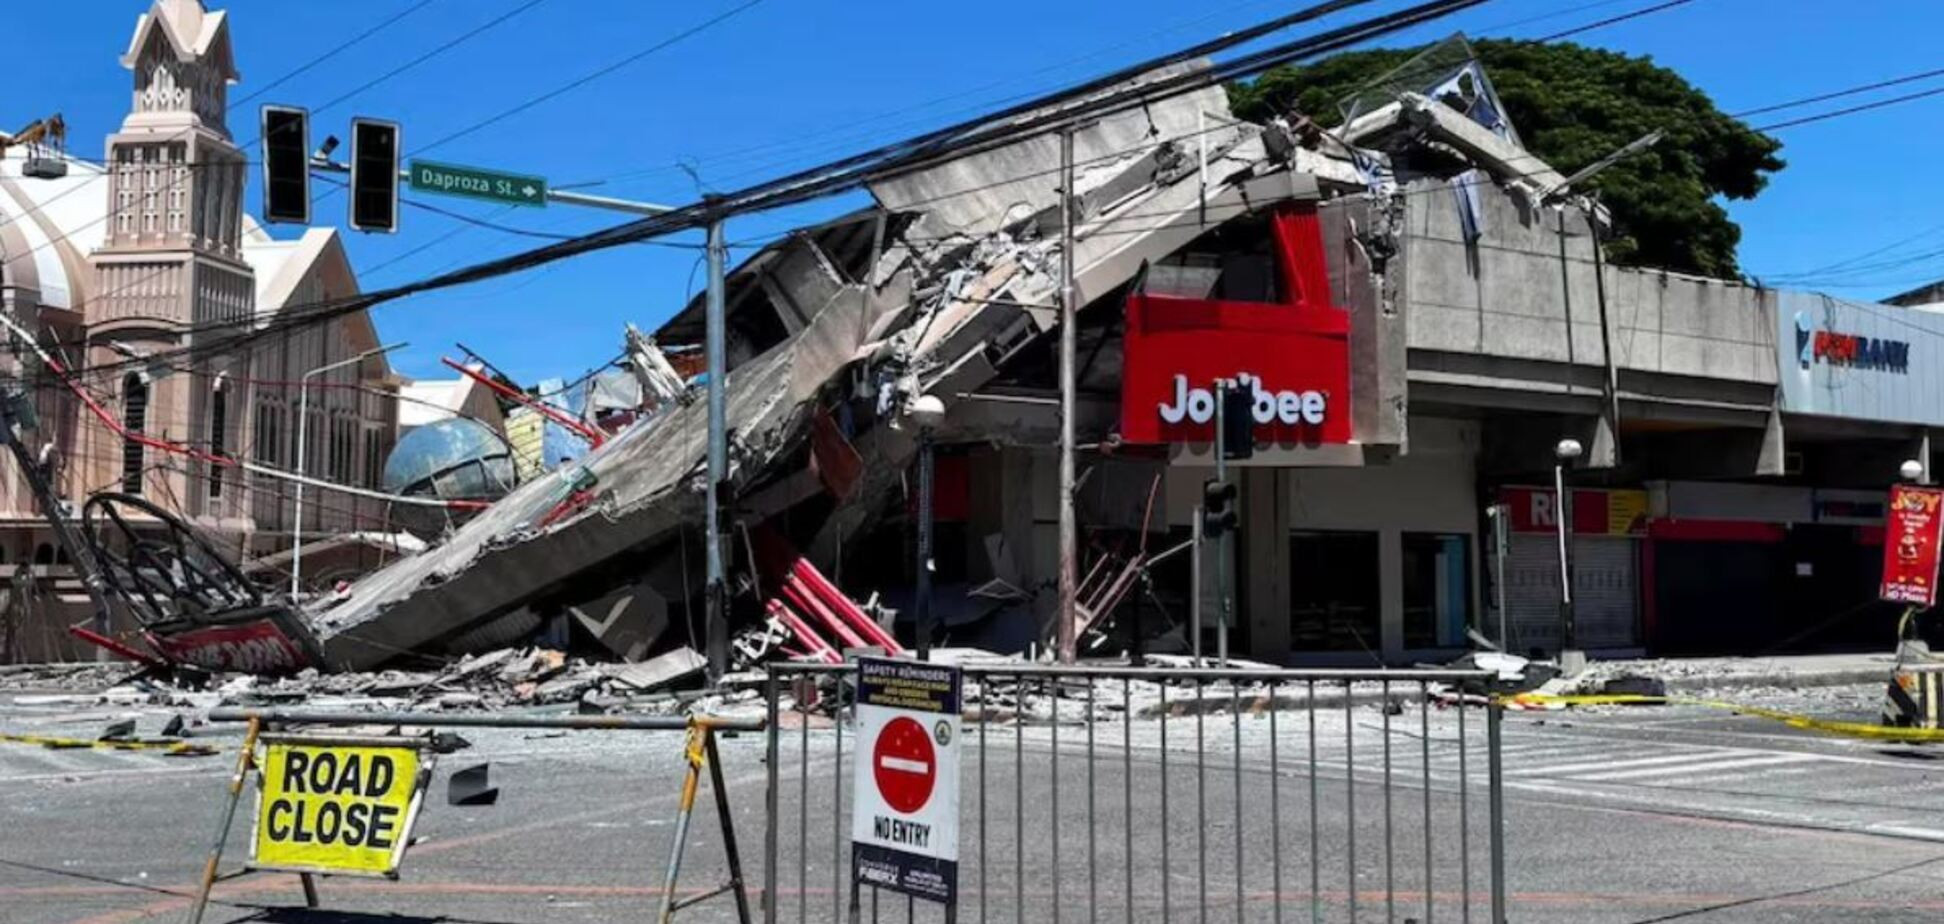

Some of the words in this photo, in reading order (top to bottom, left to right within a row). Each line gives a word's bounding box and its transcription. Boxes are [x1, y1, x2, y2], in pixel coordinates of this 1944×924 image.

[421, 169, 490, 192] Daproza
[496, 180, 517, 196] St.
[1158, 372, 1326, 425] Jobee
[1530, 491, 1557, 526] R
[863, 664, 897, 677] SAFETY
[898, 666, 951, 681] REMINDERS
[283, 751, 394, 797] ROAD
[268, 798, 399, 848] CLOSE
[874, 815, 890, 840] NO
[893, 818, 931, 849] ENTRY
